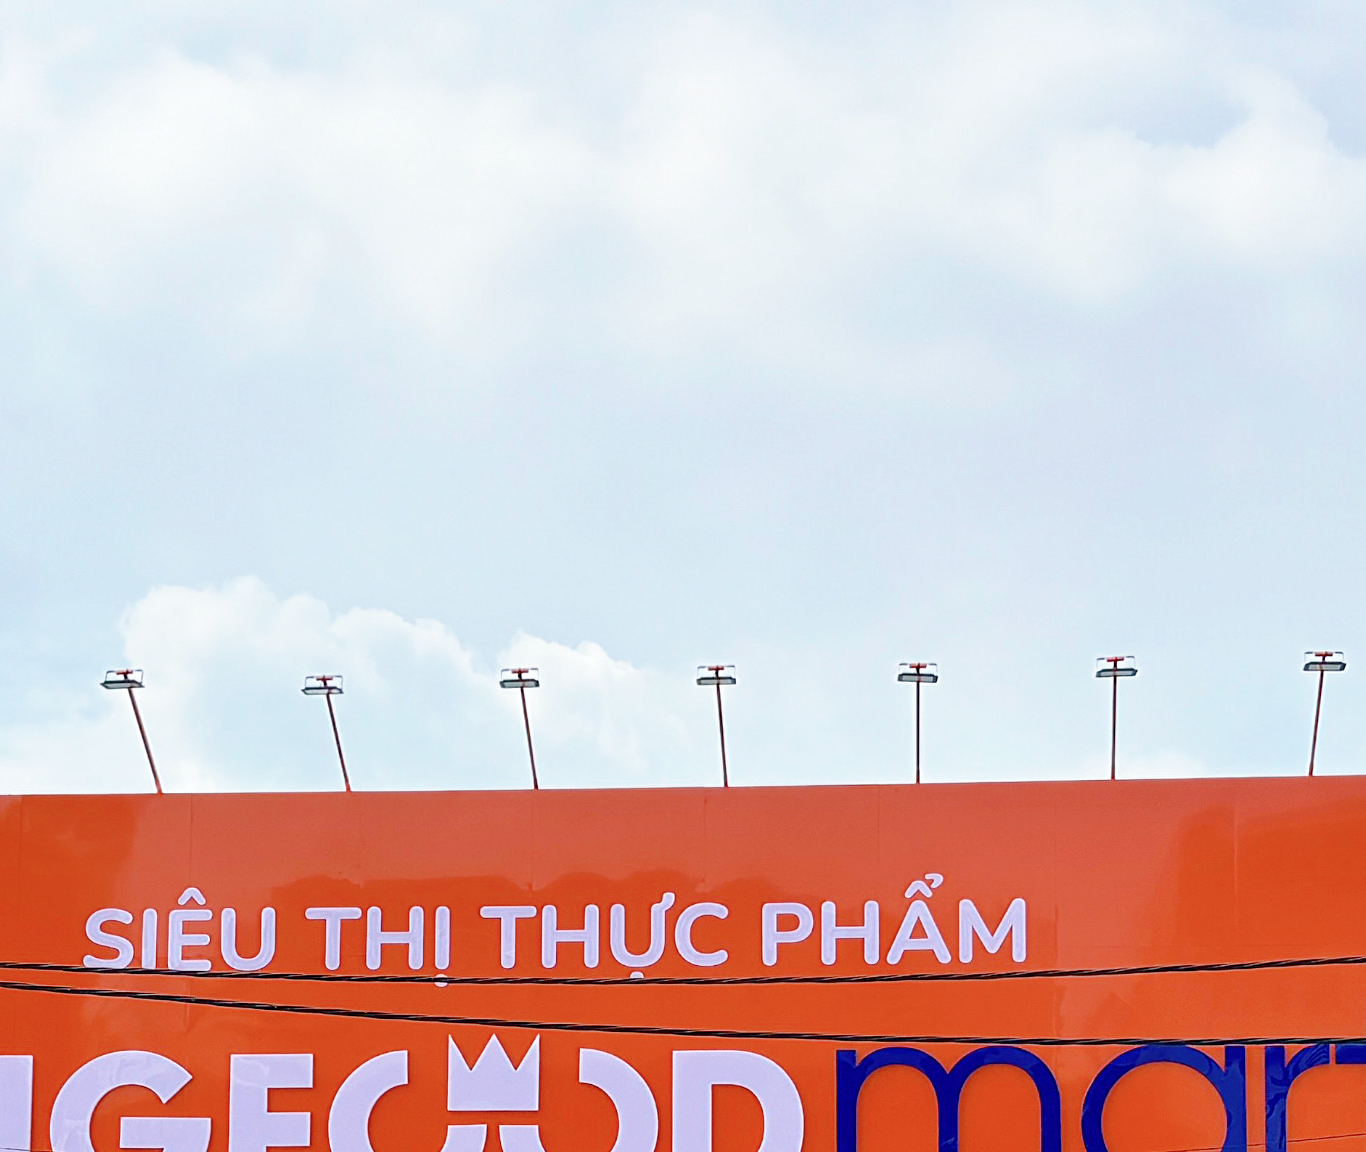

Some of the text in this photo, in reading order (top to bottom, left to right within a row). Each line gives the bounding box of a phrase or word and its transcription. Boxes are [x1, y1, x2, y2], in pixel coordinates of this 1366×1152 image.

[82, 872, 1027, 988] SIÊU THỊ THỰC PHẨM
